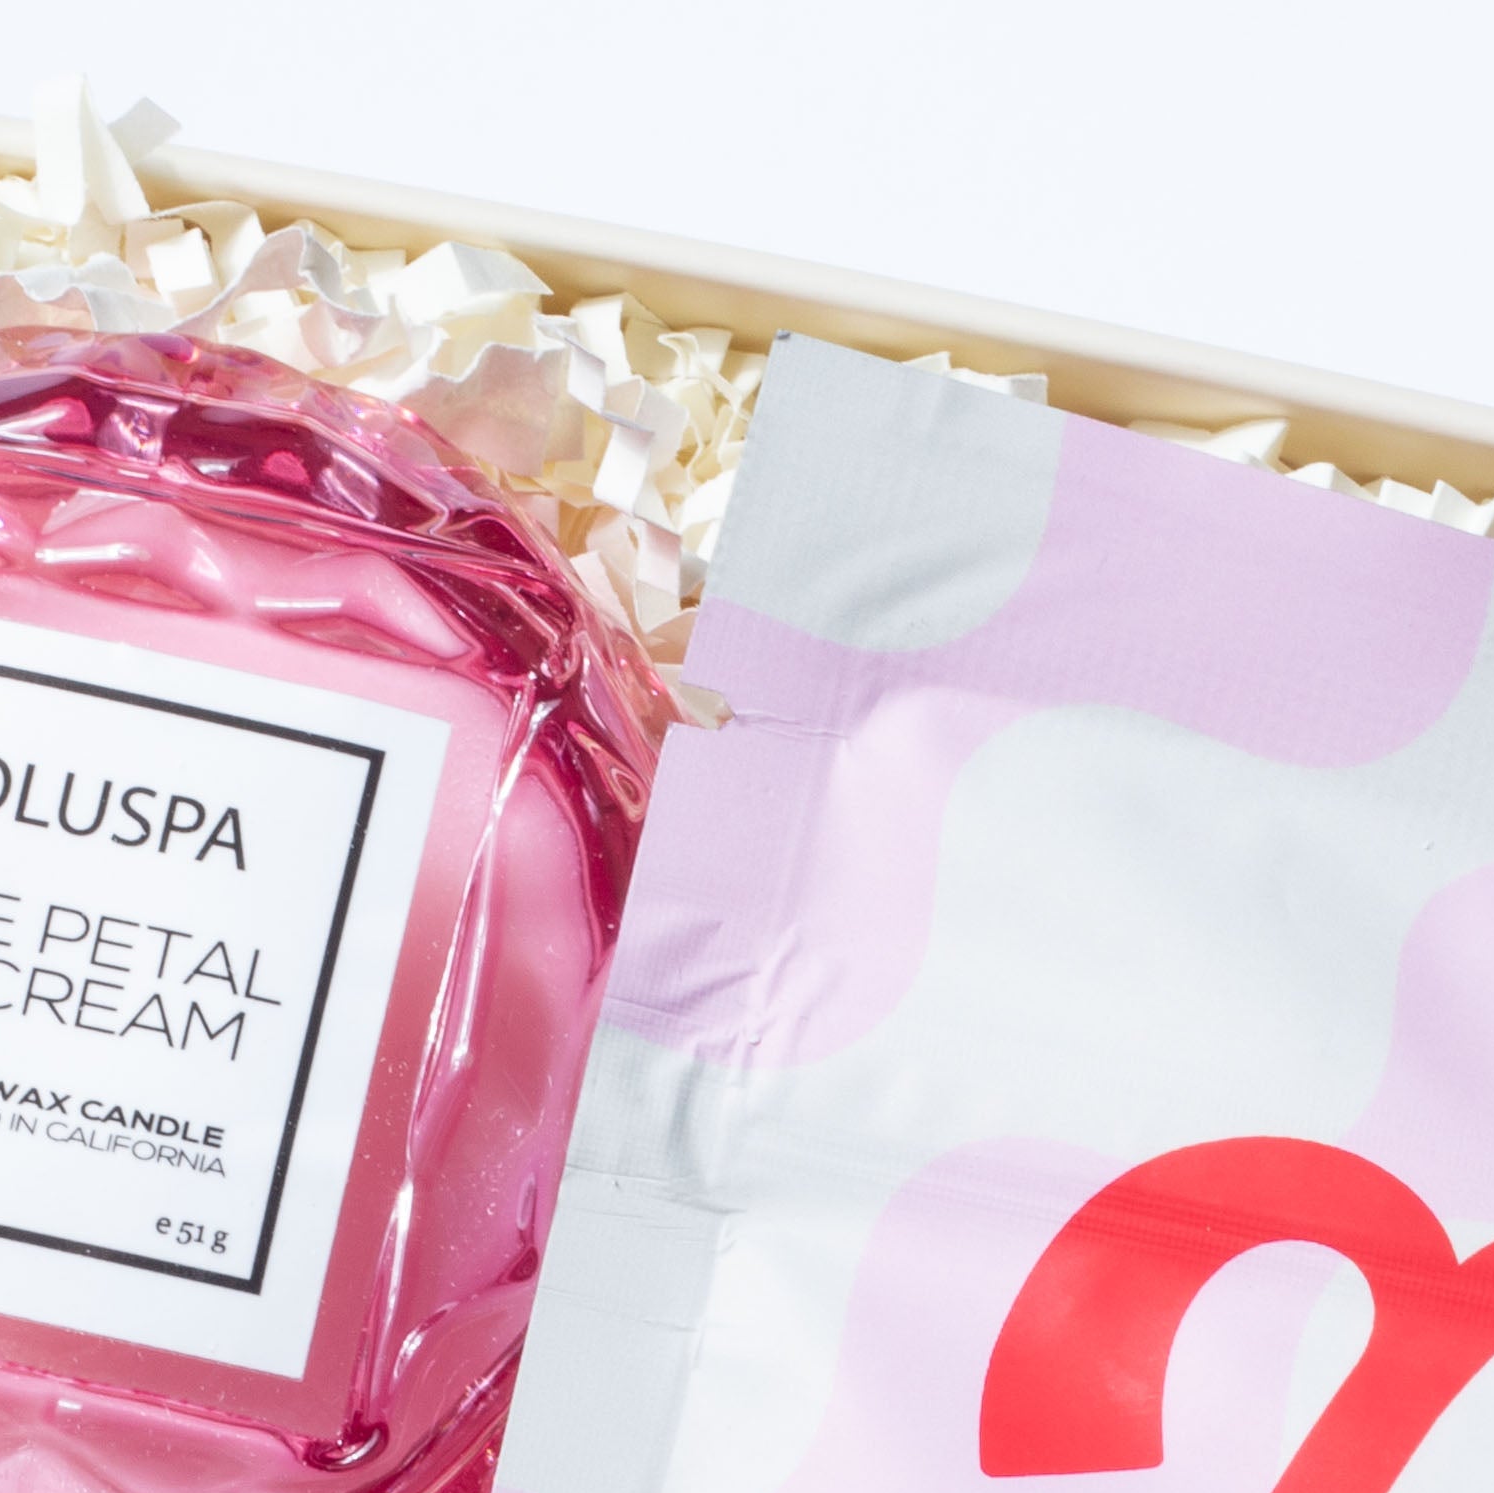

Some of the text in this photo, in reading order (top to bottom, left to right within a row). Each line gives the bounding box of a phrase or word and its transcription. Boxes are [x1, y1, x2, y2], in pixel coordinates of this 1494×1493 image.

[37, 904, 282, 1007] PETAL
[10, 1112, 38, 1132] IN
[44, 1121, 226, 1178] CALIFORNIA
[79, 1098, 226, 1149] CANDLE
